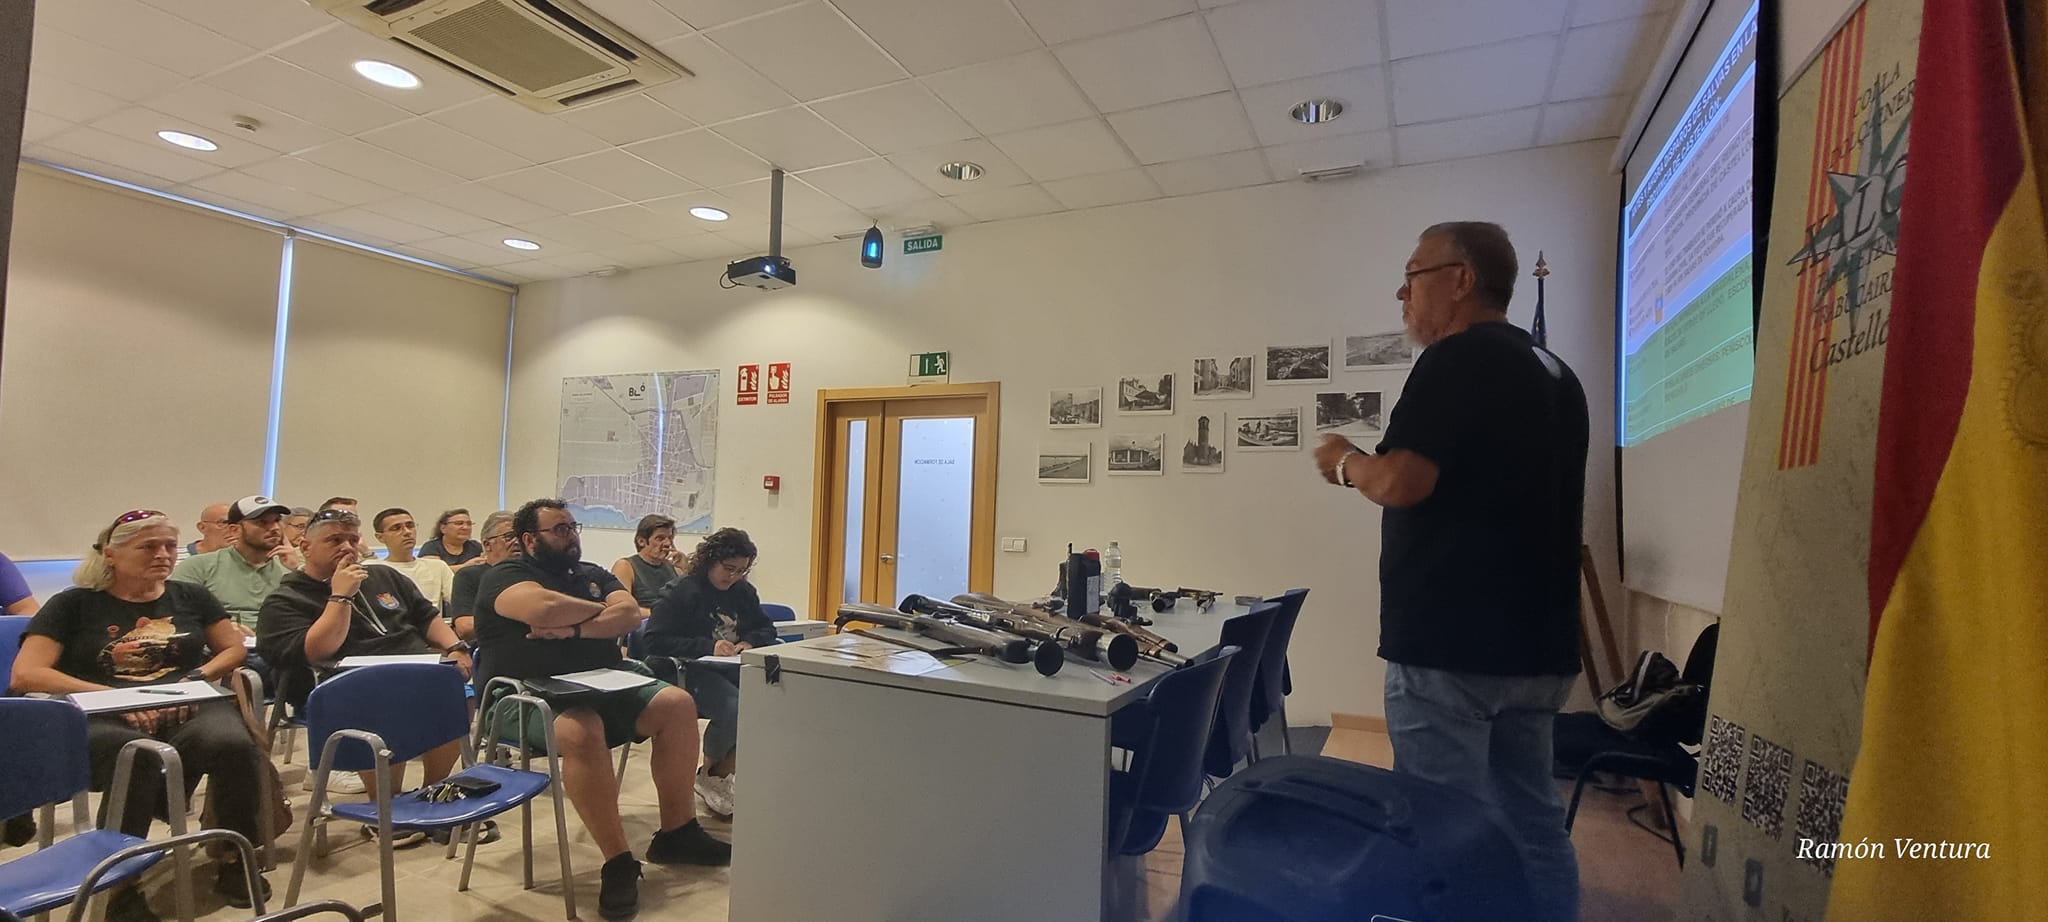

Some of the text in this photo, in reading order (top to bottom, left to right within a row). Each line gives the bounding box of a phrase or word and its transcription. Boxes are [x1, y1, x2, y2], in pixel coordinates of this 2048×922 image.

[1664, 116, 1692, 168] DISPAROS
[1702, 58, 1731, 111] SALVAS
[1731, 37, 1743, 67] EN
[1744, 19, 1758, 47] LA
[907, 238, 938, 251] SALIDA
